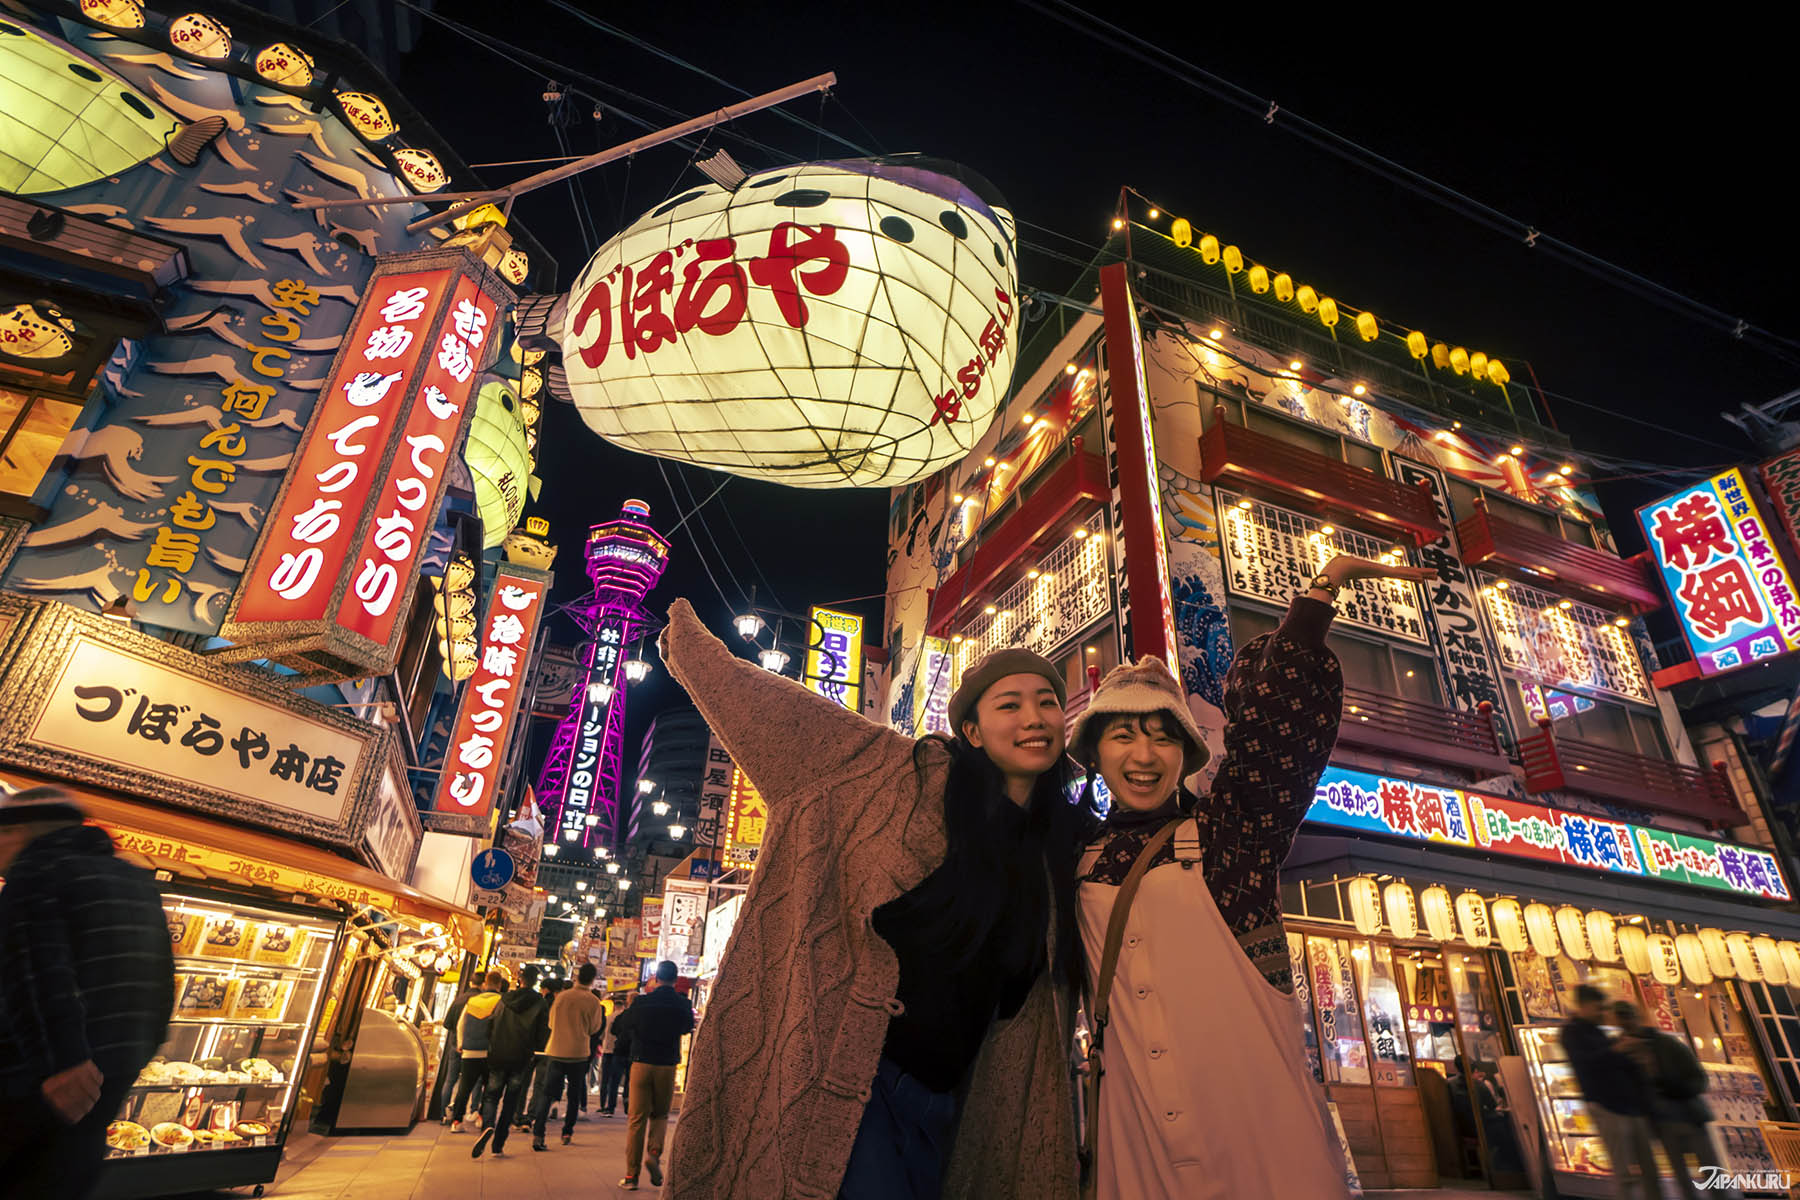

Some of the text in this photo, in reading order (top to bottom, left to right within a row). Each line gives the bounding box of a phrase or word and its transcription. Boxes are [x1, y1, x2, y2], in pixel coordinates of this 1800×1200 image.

[572, 221, 850, 369] づぼらや
[269, 286, 429, 600] 名物 てっちり
[355, 298, 488, 617] 名物 てっちり
[1718, 473, 1751, 518] 新世界
[1652, 493, 1765, 640] 横綱
[1443, 629, 1486, 658] 大阪
[1716, 638, 1779, 668] 酒処
[74, 685, 346, 795] づぼらや本店
[449, 613, 525, 806] 珍味てっちり
[562, 627, 621, 831] 社会ーションの日立
[1380, 782, 1448, 838] 横綱
[1443, 793, 1468, 841] 酒処
[1486, 811, 1565, 848] 日本一の串かつ
[1563, 816, 1624, 867] 横綱
[1614, 827, 1639, 871] 酒処
[228, 859, 280, 883] づぼらや
[302, 878, 381, 904] ふぐなら日本一
[1653, 842, 1721, 876] 日本一の串かつ
[1717, 846, 1774, 894] 横綱
[1762, 856, 1788, 898] 酒処
[1312, 943, 1338, 1043] お座敷あり
